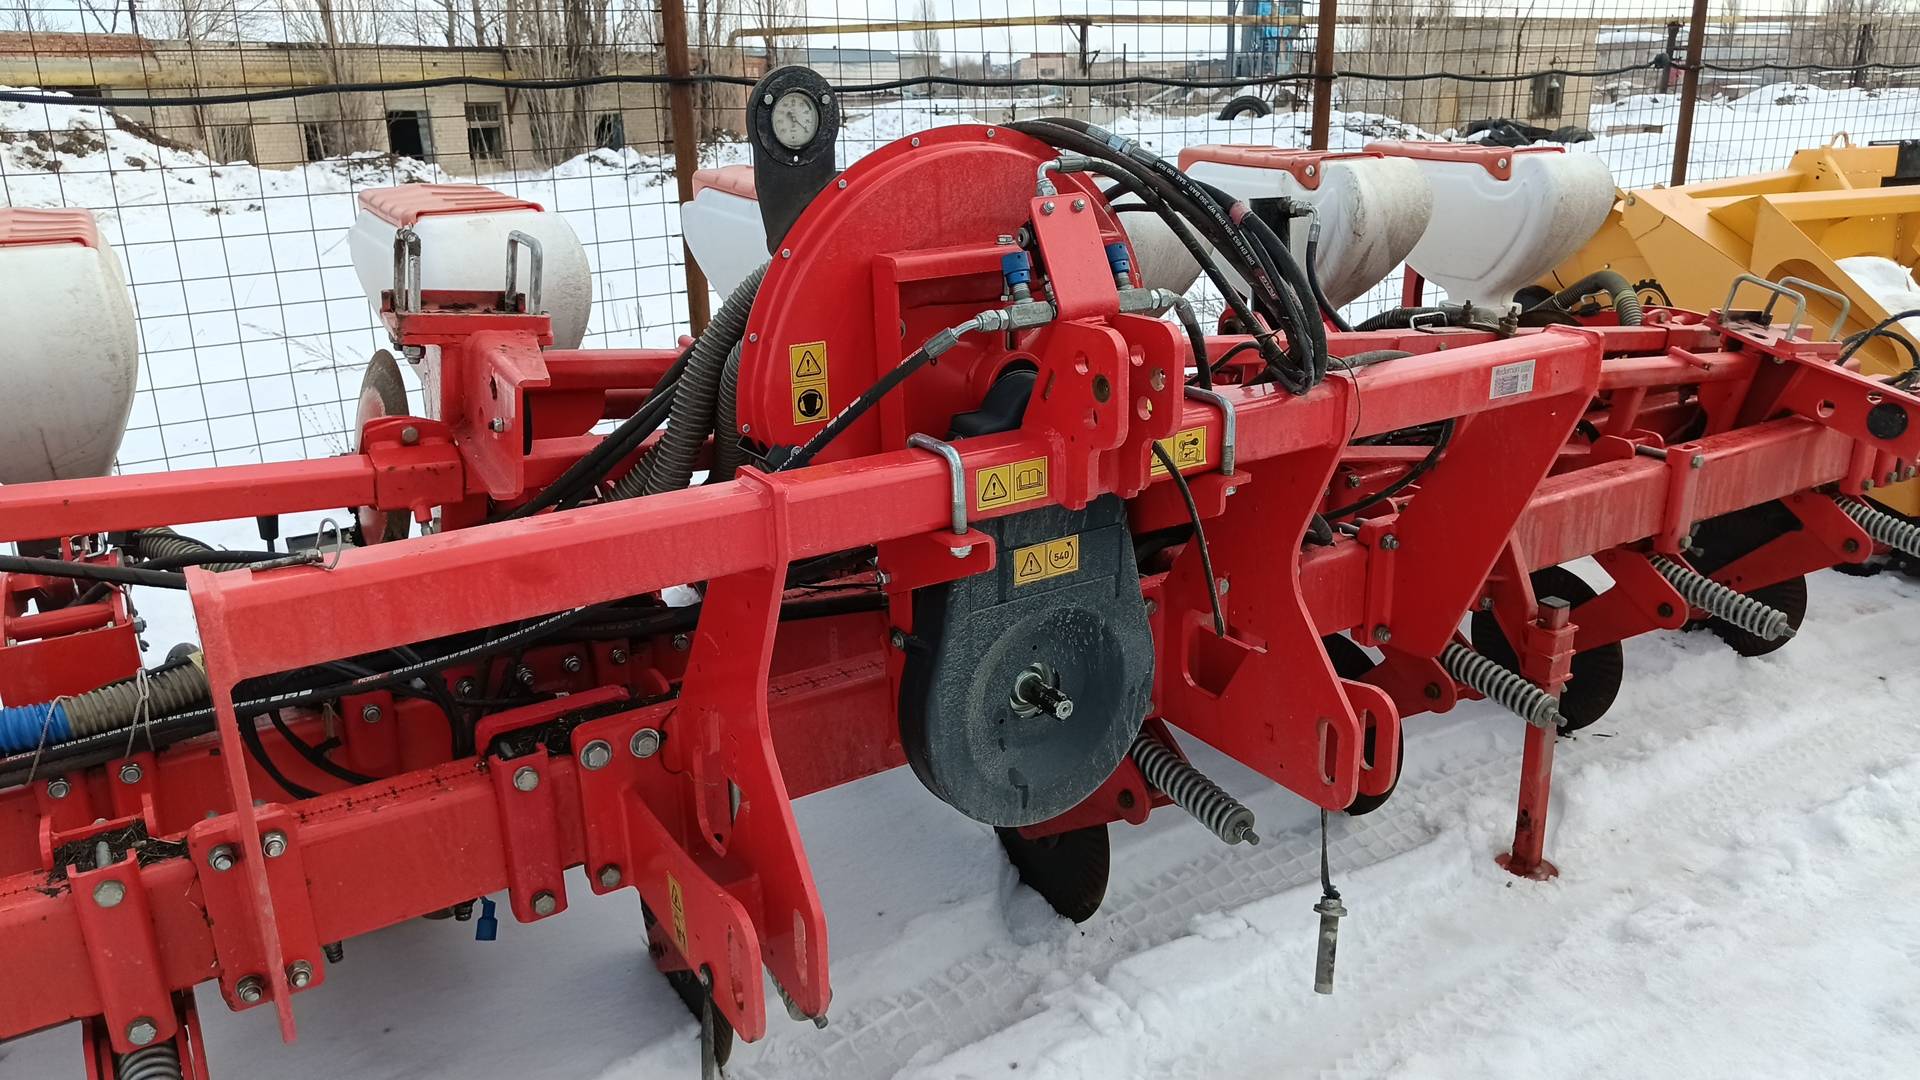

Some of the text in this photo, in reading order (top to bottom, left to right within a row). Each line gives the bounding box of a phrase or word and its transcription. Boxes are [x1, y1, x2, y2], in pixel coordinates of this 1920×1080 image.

[1166, 168, 1176, 177] 100
[1175, 174, 1188, 185] SAE
[1188, 185, 1201, 197] BAR
[1199, 195, 1209, 205] 350
[1207, 205, 1216, 215] WP
[1240, 245, 1249, 255] EN
[1245, 254, 1255, 266] DIN
[1054, 550, 1070, 562] 540
[52, 743, 65, 751] DIN
